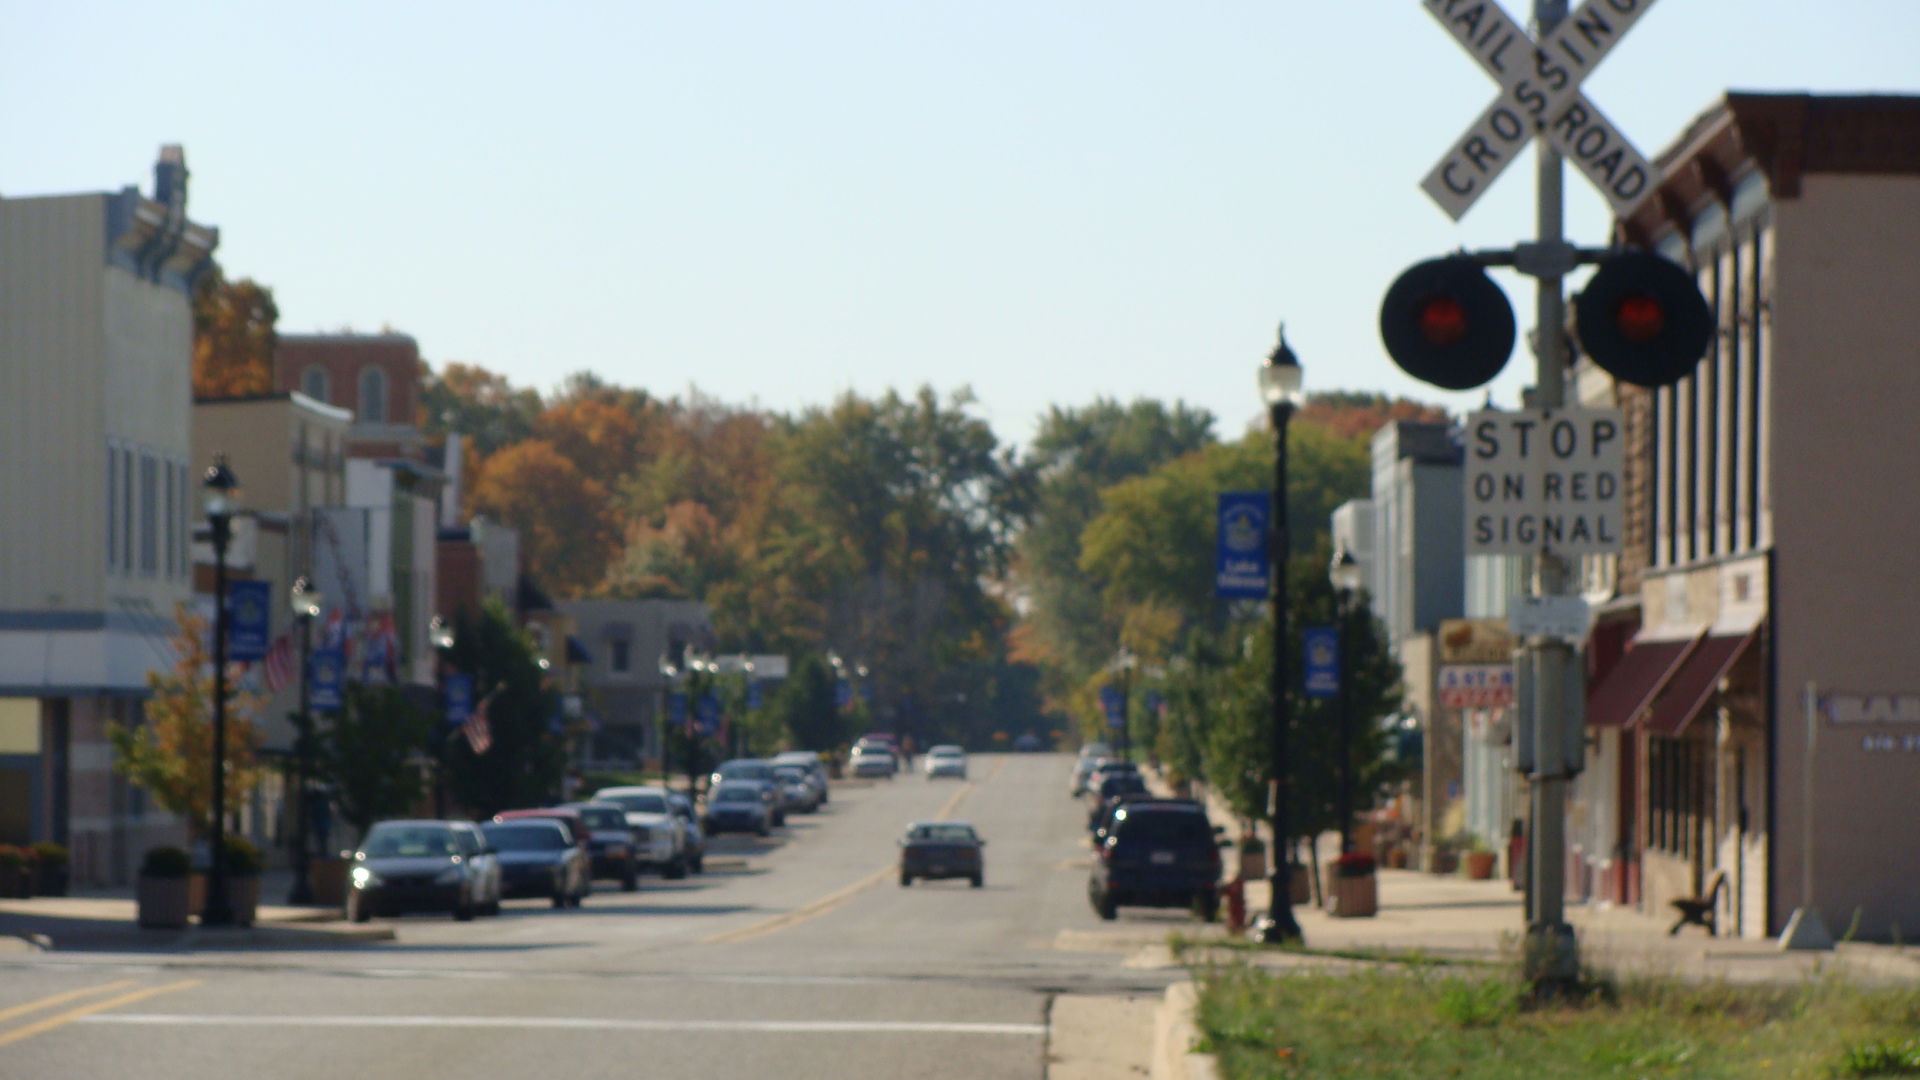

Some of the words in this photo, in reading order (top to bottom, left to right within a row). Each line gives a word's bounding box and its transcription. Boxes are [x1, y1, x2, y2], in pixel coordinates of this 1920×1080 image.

[1555, 102, 1649, 201] ROAD
[1475, 419, 1617, 459] STOP
[1474, 473, 1524, 502] ON
[1543, 472, 1617, 501] RED
[1475, 515, 1615, 545] SIGNAL
